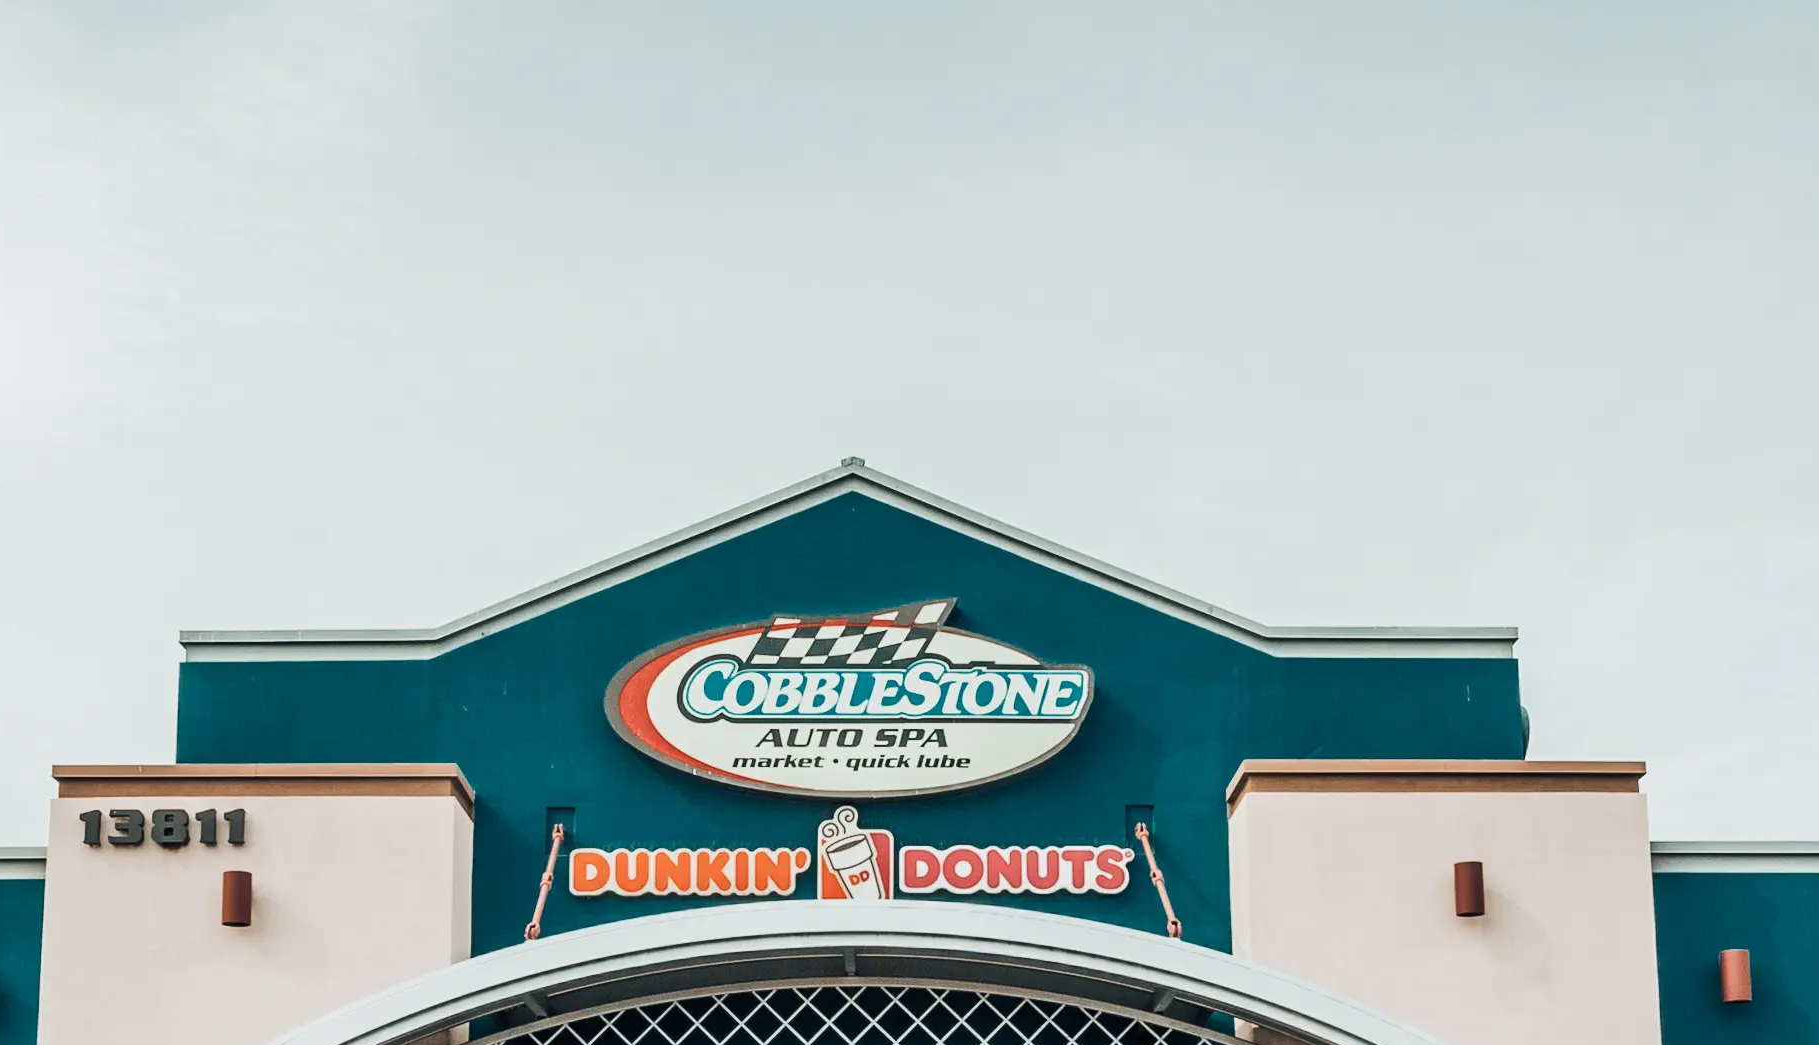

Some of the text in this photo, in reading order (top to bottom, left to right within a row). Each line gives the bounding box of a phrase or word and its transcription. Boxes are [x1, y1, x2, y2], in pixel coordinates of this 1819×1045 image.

[686, 661, 1083, 718] COBBLESTONE
[755, 728, 949, 748] AUTO SPA
[731, 753, 971, 771] market quick lube
[80, 809, 246, 848] 13811
[572, 848, 1126, 893] DUNKIN' DONUTS
[848, 870, 870, 886] DD
